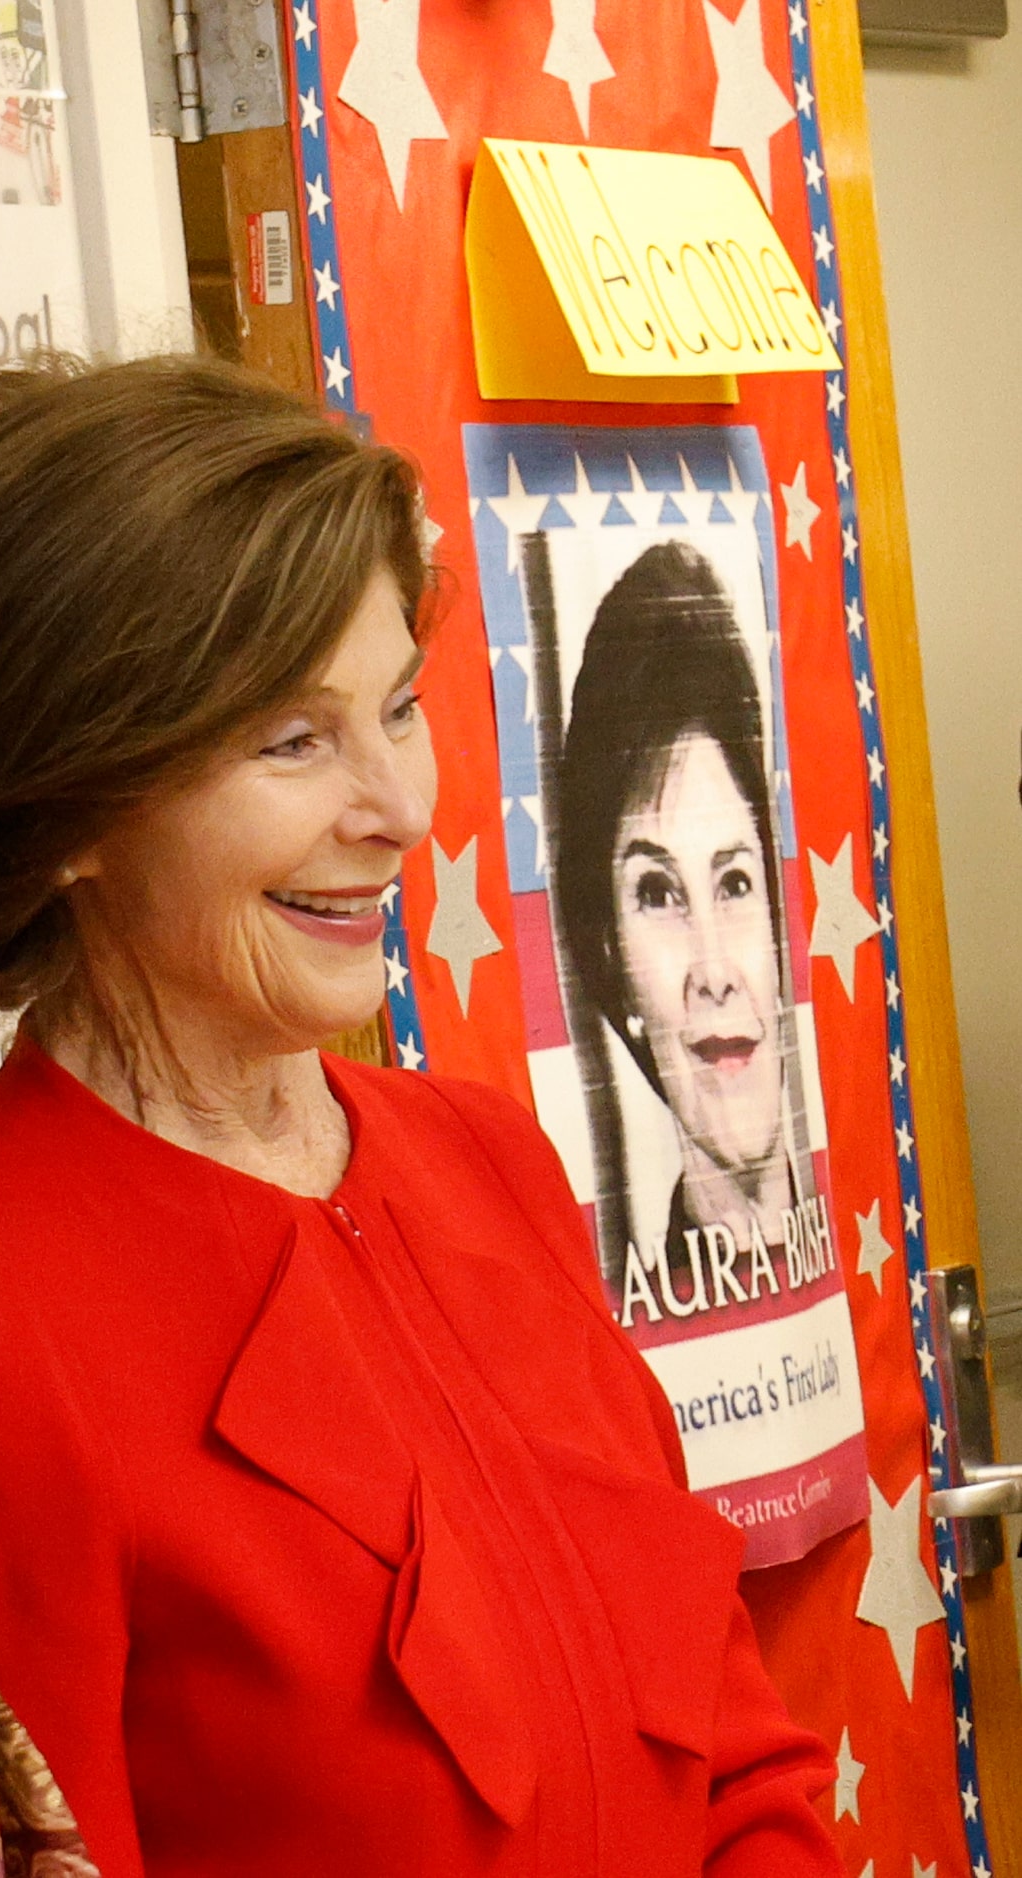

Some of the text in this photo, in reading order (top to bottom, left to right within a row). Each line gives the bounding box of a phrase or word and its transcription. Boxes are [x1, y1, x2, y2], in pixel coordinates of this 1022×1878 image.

[497, 148, 823, 360] Welcome
[612, 1194, 836, 1328] AURA BUSH
[674, 1362, 780, 1434] erica's
[781, 1355, 818, 1407] First
